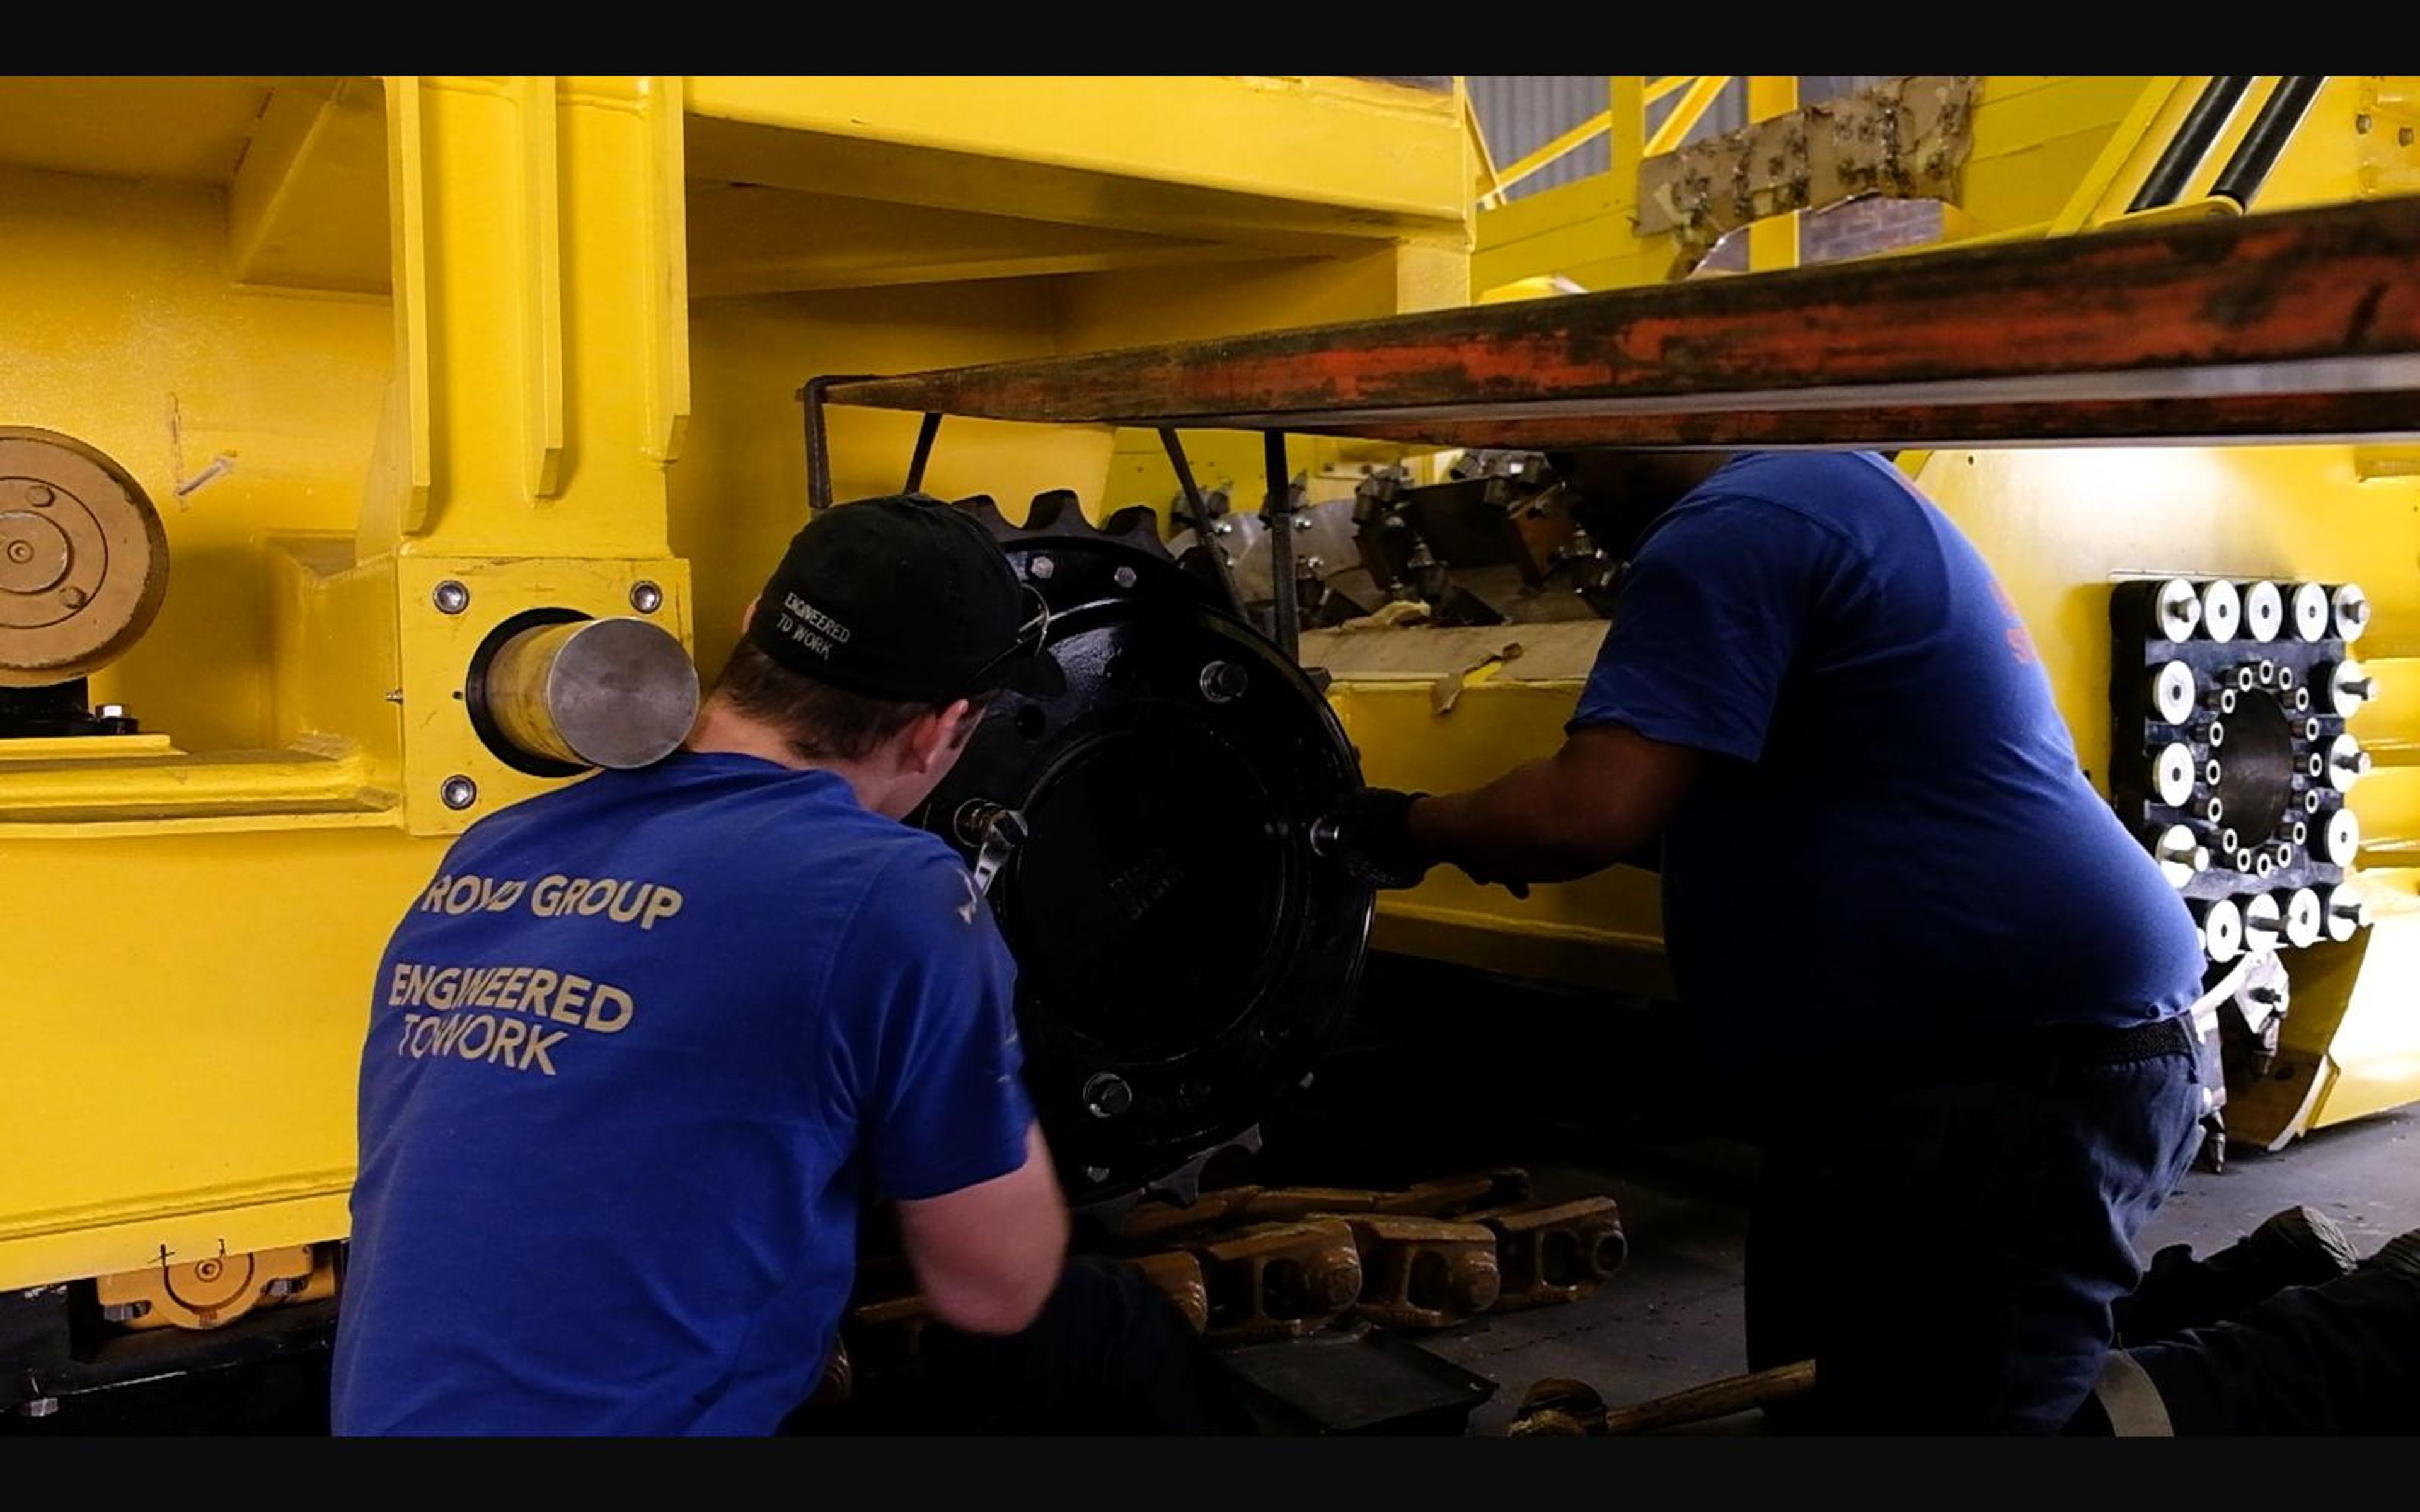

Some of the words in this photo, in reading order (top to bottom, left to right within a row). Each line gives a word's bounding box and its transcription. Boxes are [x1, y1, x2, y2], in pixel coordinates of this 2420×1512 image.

[777, 613, 793, 632] TO
[792, 624, 833, 660] WORK
[531, 874, 683, 931] GROUP
[398, 1013, 441, 1060] TO
[432, 1012, 568, 1076] WORK
